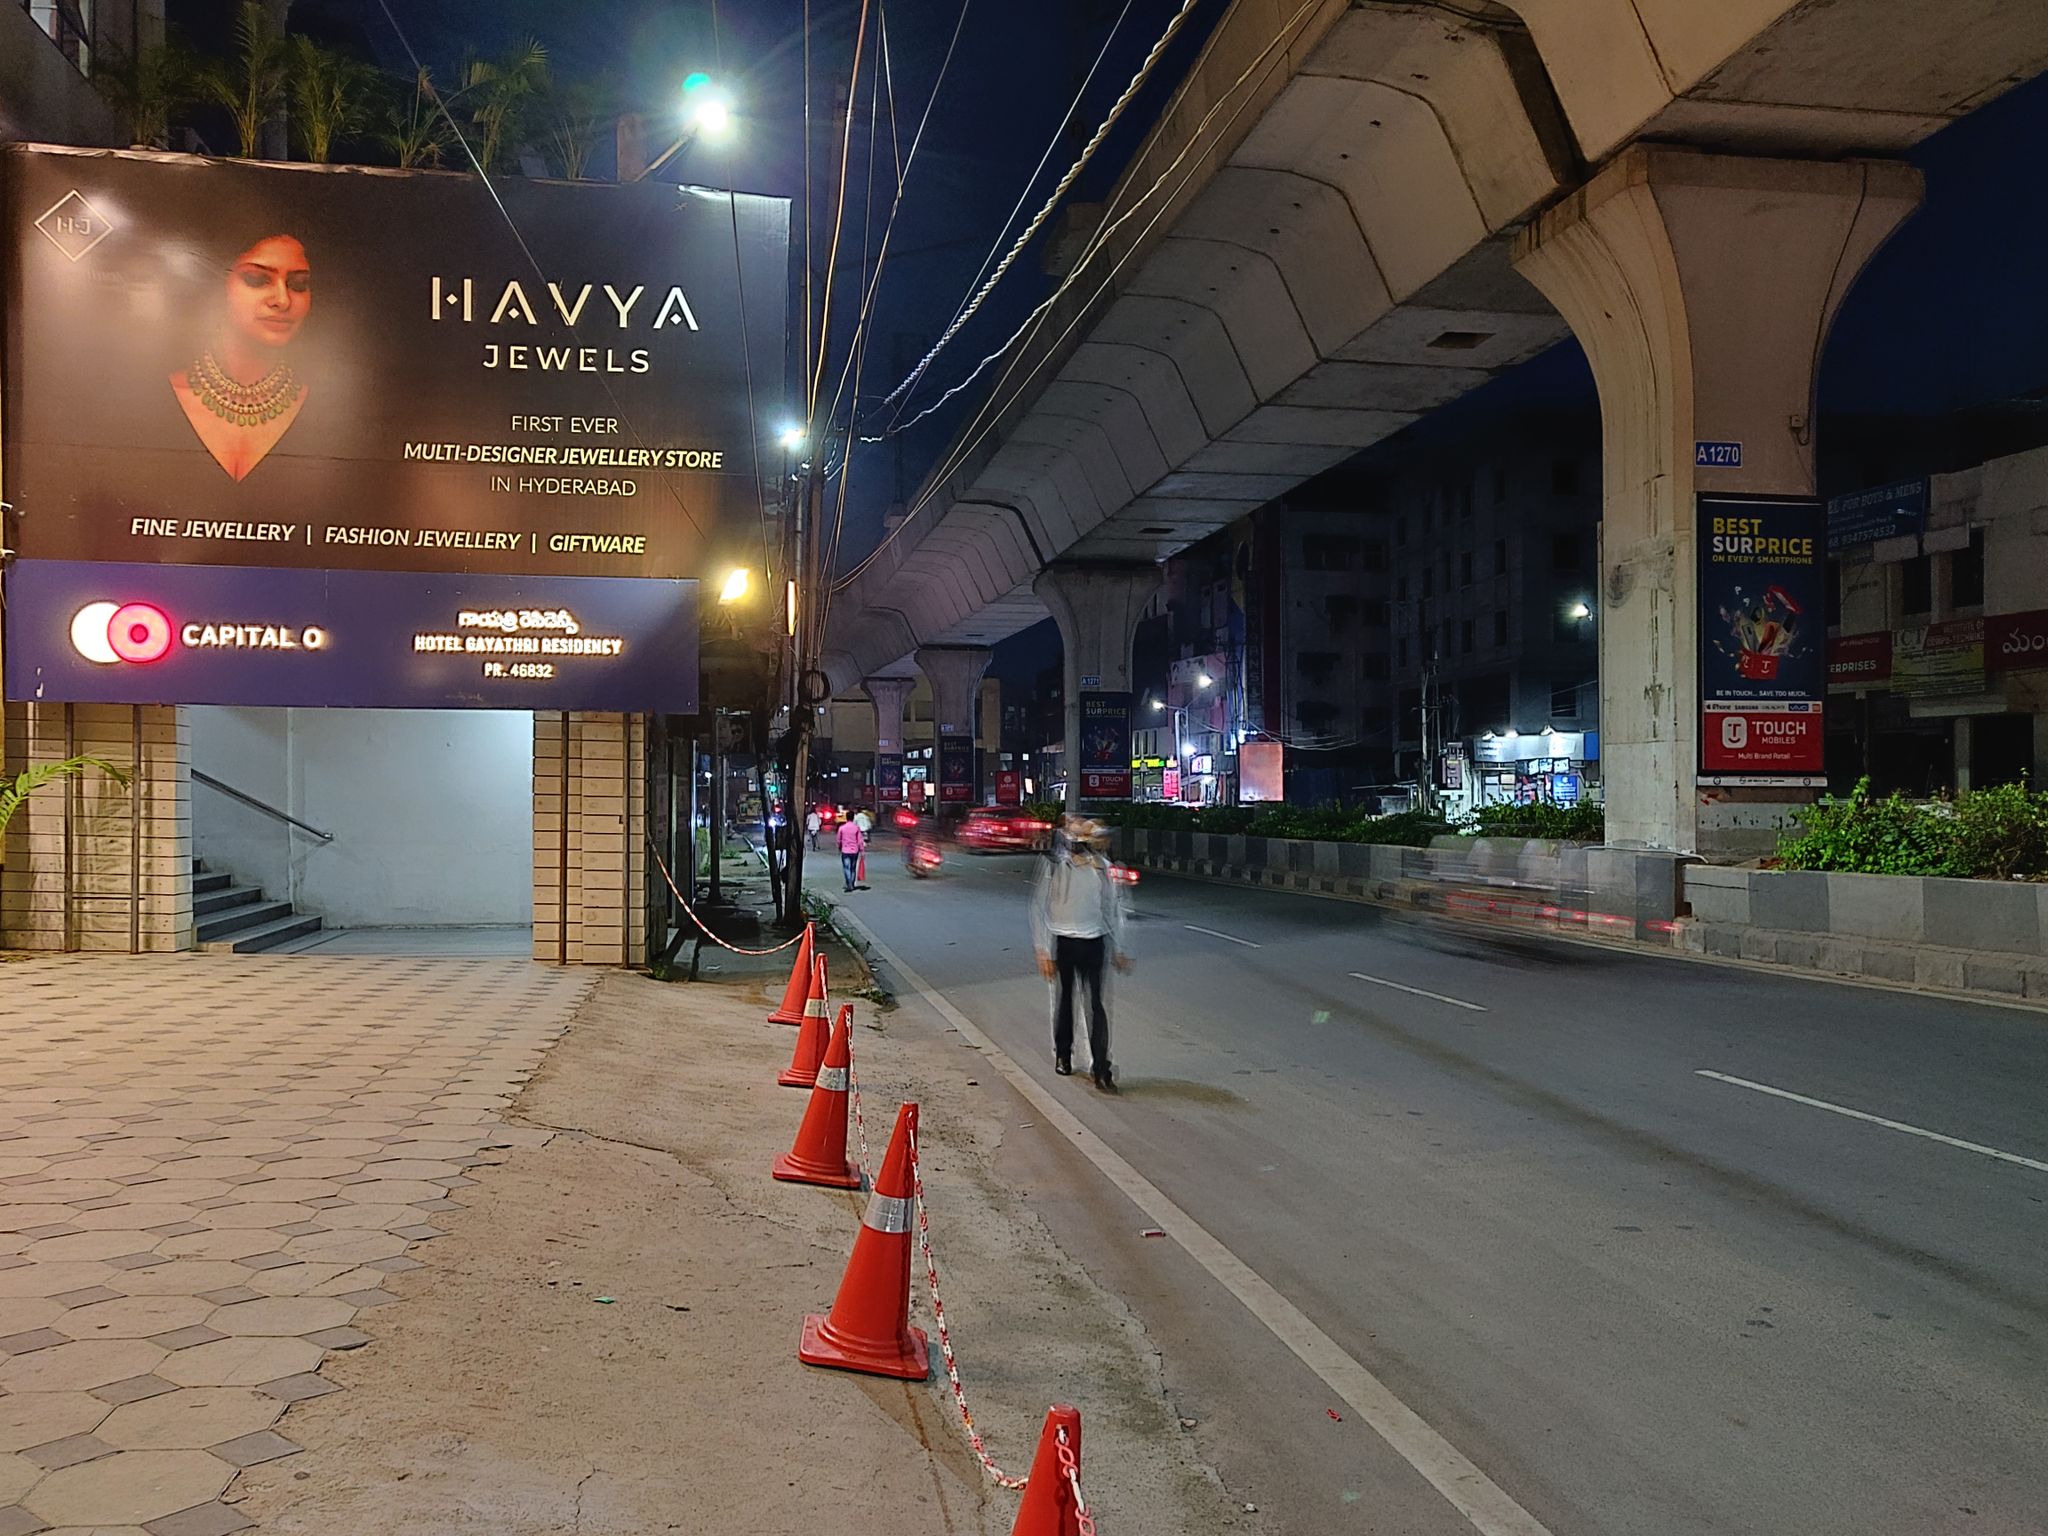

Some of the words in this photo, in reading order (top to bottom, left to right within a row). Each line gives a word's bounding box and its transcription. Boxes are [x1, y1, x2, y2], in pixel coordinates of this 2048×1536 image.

[431, 276, 699, 331] HAVYA
[482, 344, 650, 373] JEWELS
[511, 415, 563, 432] FIRST
[570, 417, 618, 434] EVER
[403, 442, 558, 465] MULTI-DESIGNER
[559, 446, 665, 467] JEWELLERY
[664, 449, 724, 469] STORE
[1697, 445, 1708, 462] A
[1710, 446, 1740, 463] 1270
[490, 476, 511, 492] IN
[518, 477, 637, 496] HYDERABAD
[130, 517, 177, 537] FINE
[181, 519, 296, 541] JEWELLERY
[325, 526, 408, 547] FASHION
[413, 528, 522, 550] JEWELLERY
[548, 534, 646, 554] GIFTWARE
[1712, 517, 1762, 535] BEST
[1712, 536, 1813, 555] SURPRICE
[1712, 554, 1725, 563] ON
[1727, 555, 1754, 564] EVERY
[1757, 556, 1813, 566] SMARTPHONE
[181, 624, 296, 648] CAPITAL
[301, 626, 323, 648] O
[414, 636, 464, 652] HOTEL
[465, 637, 539, 654] GAYATHRI
[541, 638, 623, 656] RESIDENCY
[510, 663, 554, 678] 46832
[1828, 660, 1877, 673] ERPRISES
[1751, 721, 1806, 735] TOUCH
[1738, 752, 1752, 760] Multi
[1754, 752, 1772, 760] Brand
